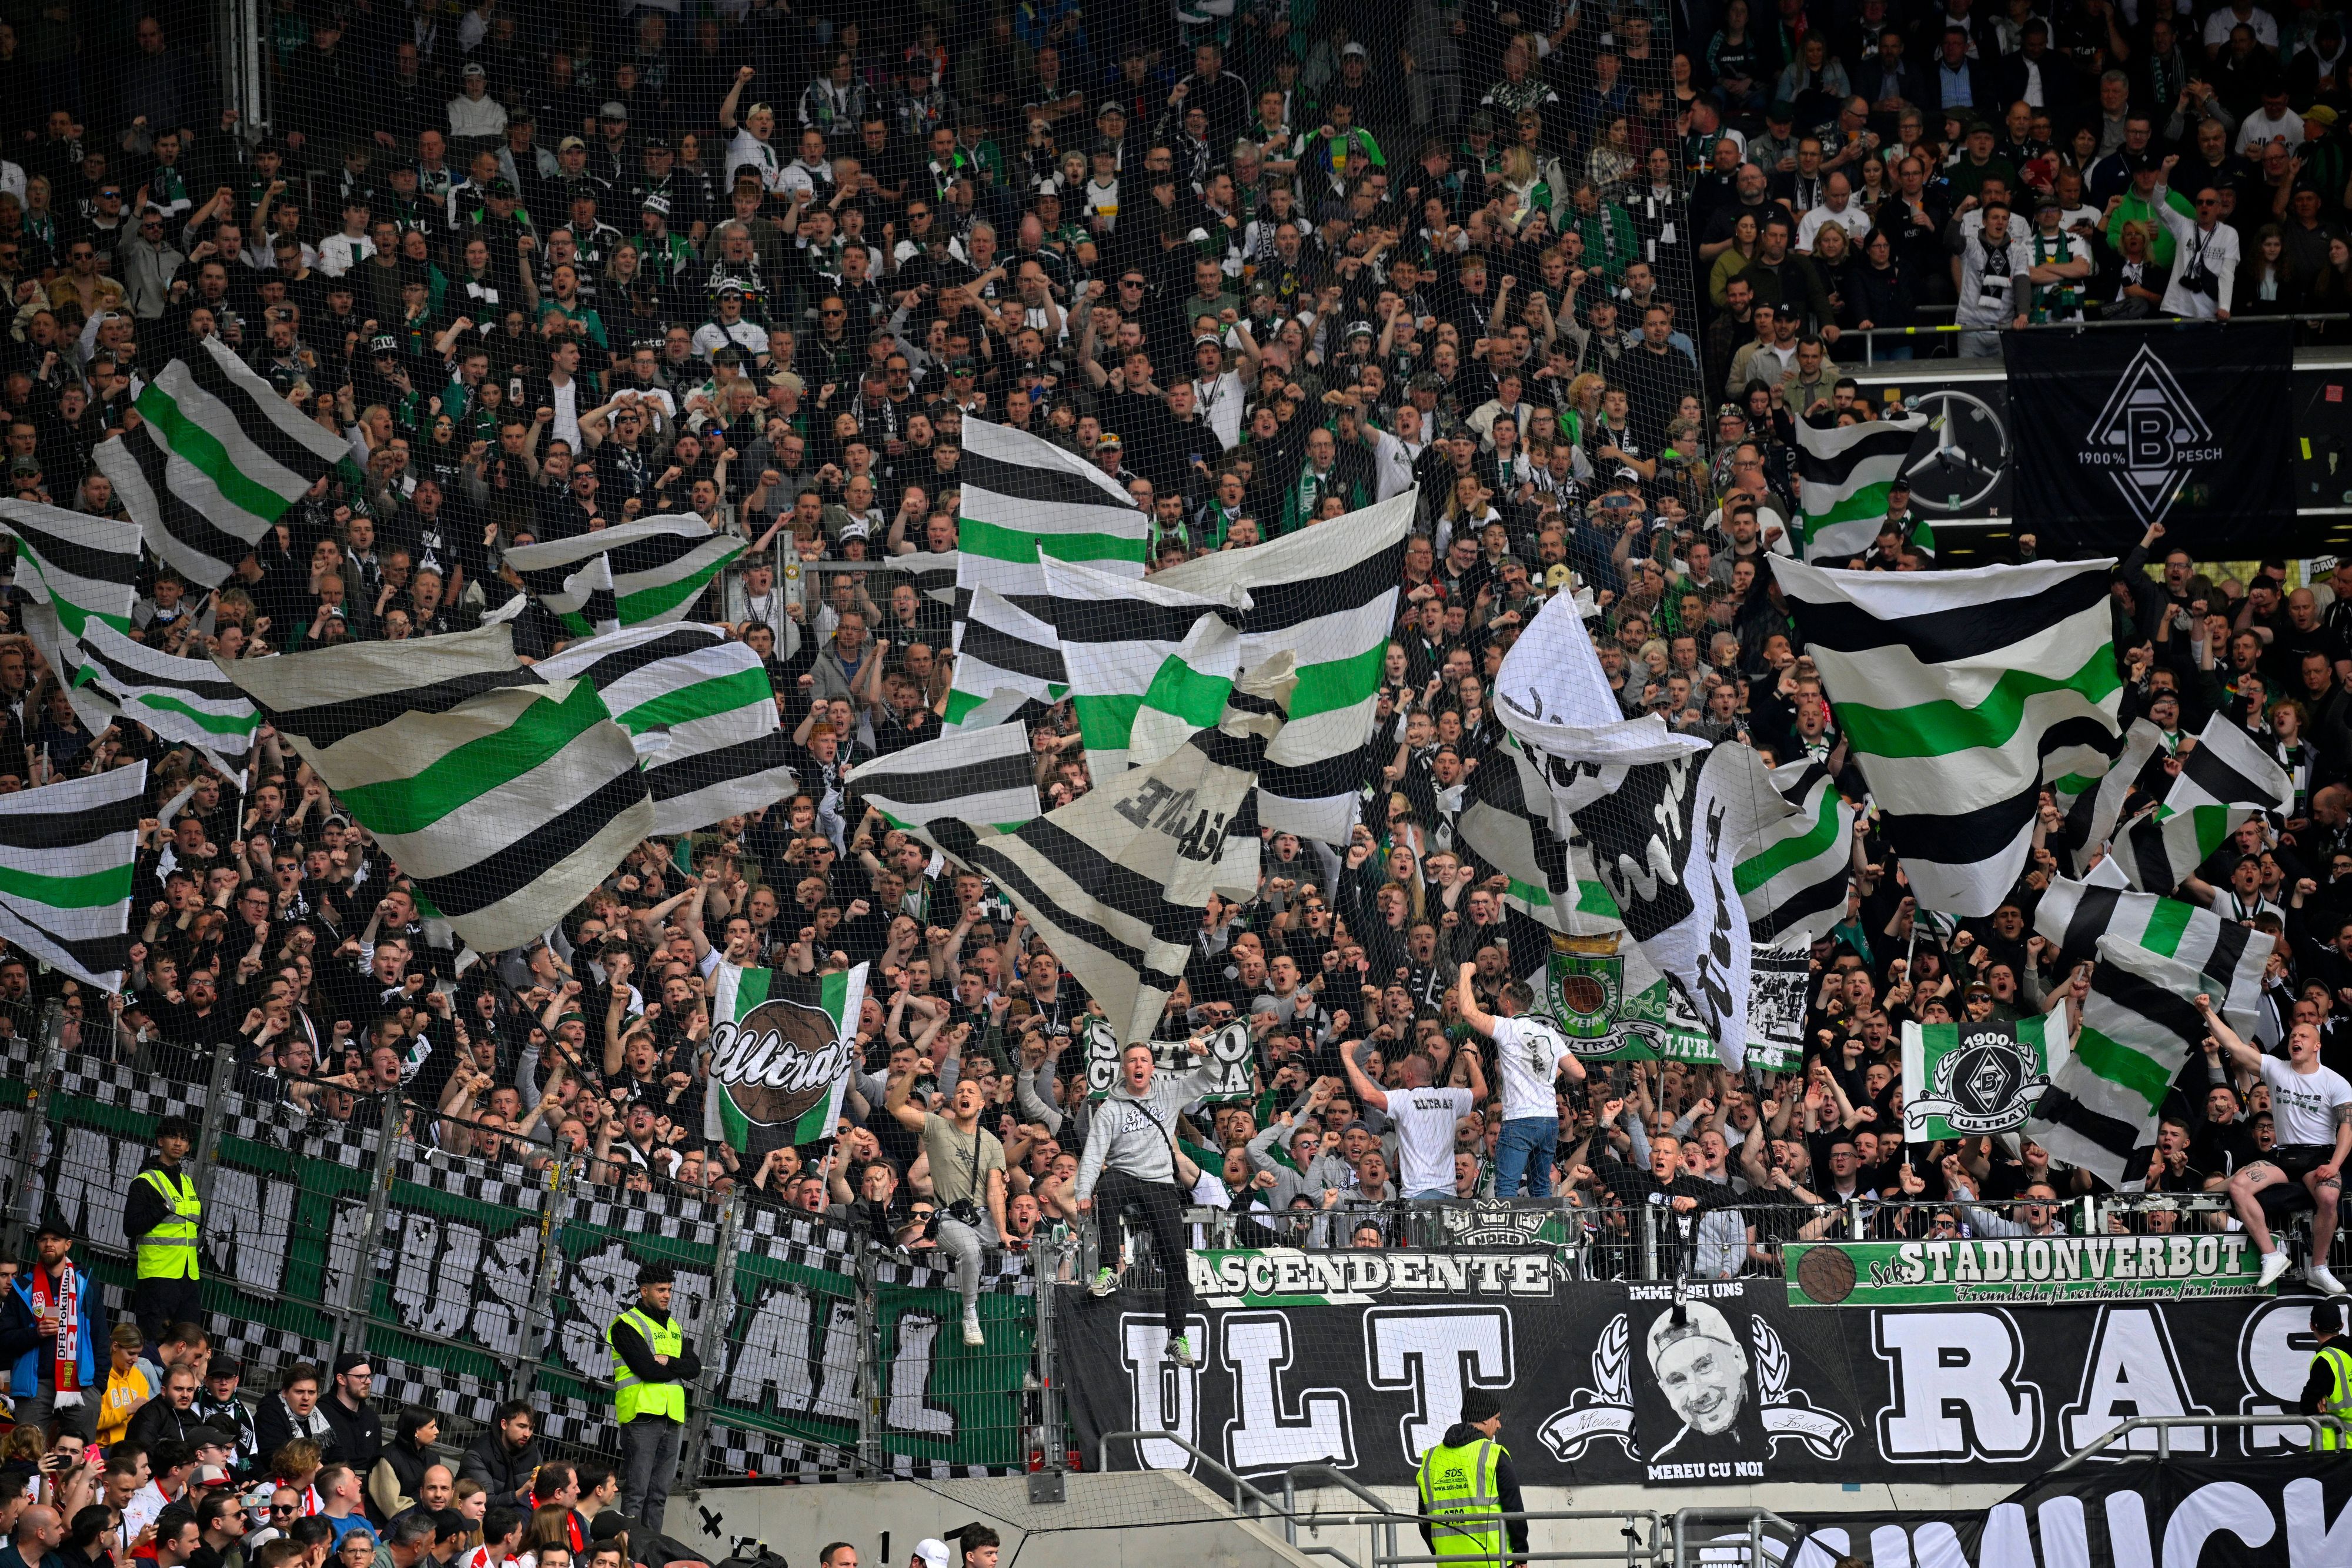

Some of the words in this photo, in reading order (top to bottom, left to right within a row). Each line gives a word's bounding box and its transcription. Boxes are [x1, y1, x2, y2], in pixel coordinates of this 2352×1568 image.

[2074, 46, 2097, 55] flat
[2077, 452, 2126, 465] 1900%
[2177, 447, 2223, 463] PESCH
[1750, 946, 1810, 961] endente
[1963, 1032, 2009, 1049] 1900
[709, 1021, 857, 1094] Ultras
[1414, 1097, 1454, 1111] ULTRAS
[1475, 1235, 1519, 1245] NORD
[1899, 1235, 2249, 1284] STADIONVERBOT
[1194, 1253, 1554, 1297] ASCENDENTE
[1629, 1285, 1673, 1300] IMME
[1686, 1284, 1709, 1299] BEI
[1712, 1282, 1744, 1298] UNS
[1955, 1283, 2067, 1307] Freundschaft
[2070, 1282, 2141, 1300] verbindet
[2144, 1285, 2173, 1299] uns
[2177, 1281, 2206, 1302] für
[1444, 1468, 1463, 1478] SDS
[1648, 1462, 1705, 1480] MEREU
[1708, 1462, 1733, 1478] CU
[1736, 1461, 1764, 1477] NOI
[1434, 1483, 1469, 1492] www.sds-bw.de
